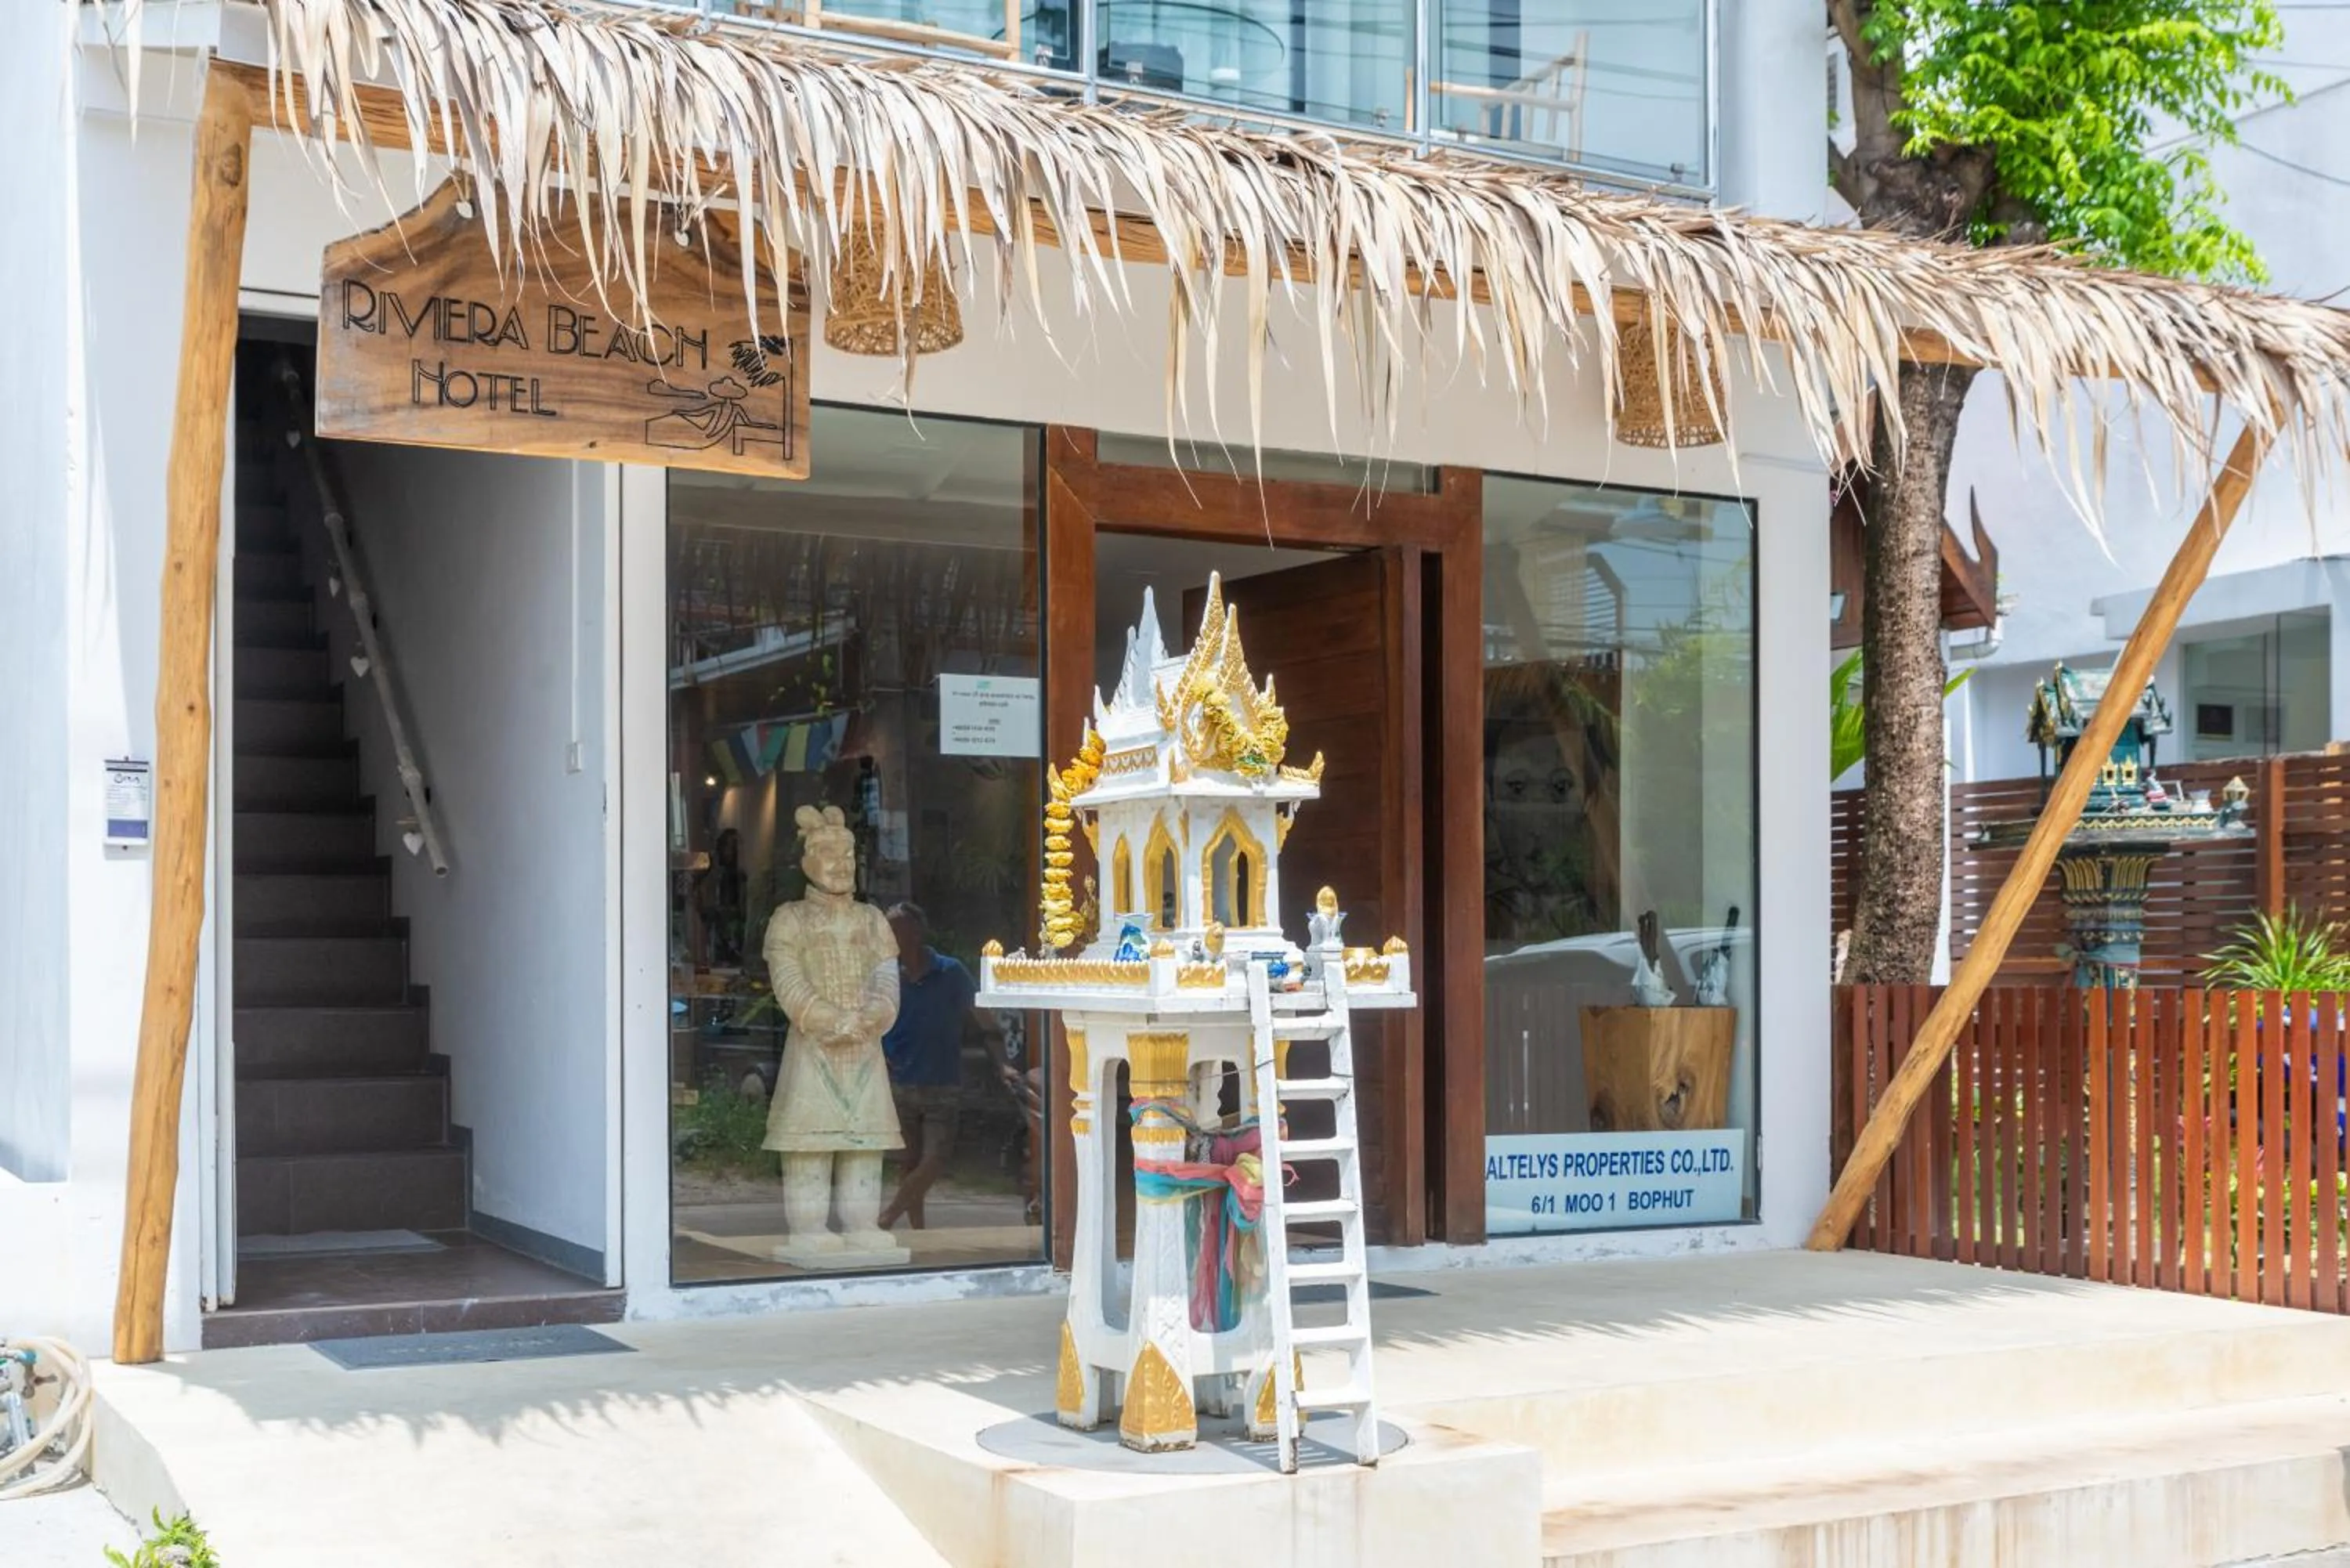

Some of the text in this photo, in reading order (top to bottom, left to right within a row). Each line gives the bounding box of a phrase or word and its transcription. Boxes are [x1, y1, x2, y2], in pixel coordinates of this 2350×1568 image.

[342, 278, 708, 371] RIVIERA BEACH
[411, 359, 558, 417] HOTEL
[1485, 1148, 1734, 1180] ALTELYS PROPERTIES CO.,LTD.
[1531, 1189, 1695, 1215] 6/1 MOO 1 BOPHUT
